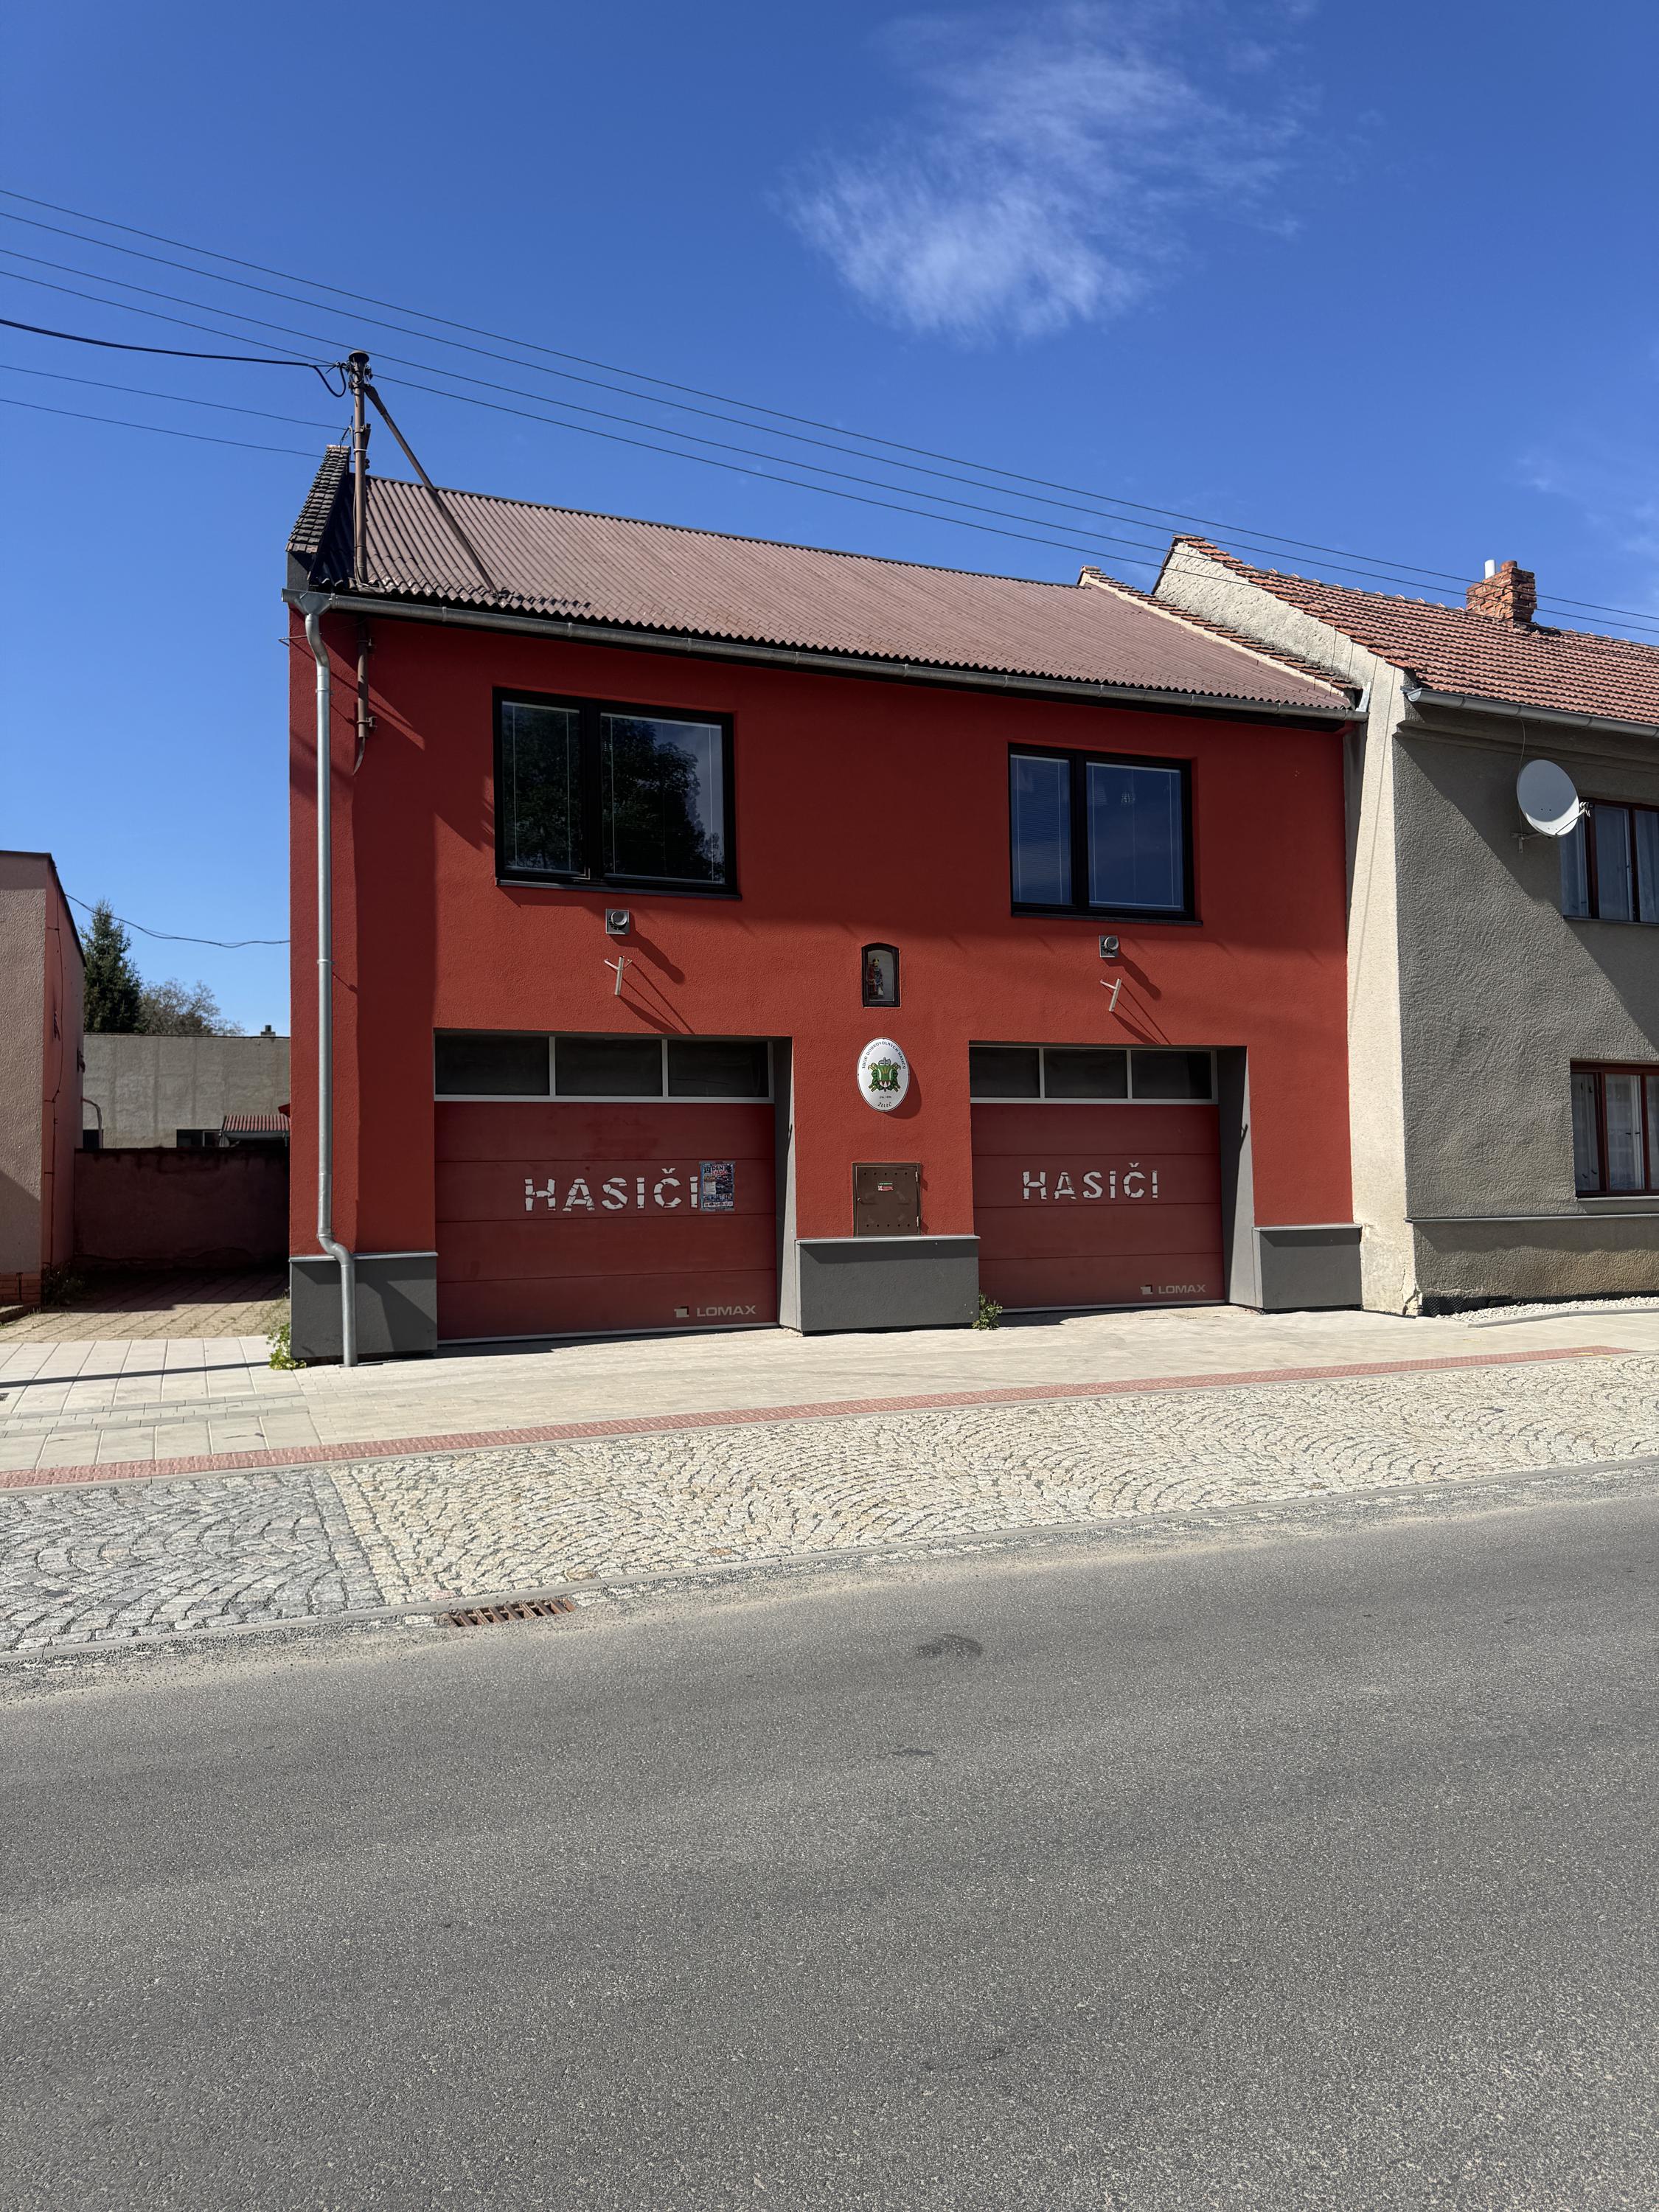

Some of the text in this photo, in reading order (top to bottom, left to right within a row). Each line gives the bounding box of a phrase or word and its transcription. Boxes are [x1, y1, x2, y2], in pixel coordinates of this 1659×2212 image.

[524, 1167, 698, 1211] HASIČI
[1022, 1162, 1158, 1200] HASIČI
[1158, 1284, 1206, 1295] LOMAX
[696, 1304, 757, 1317] LOMAX
